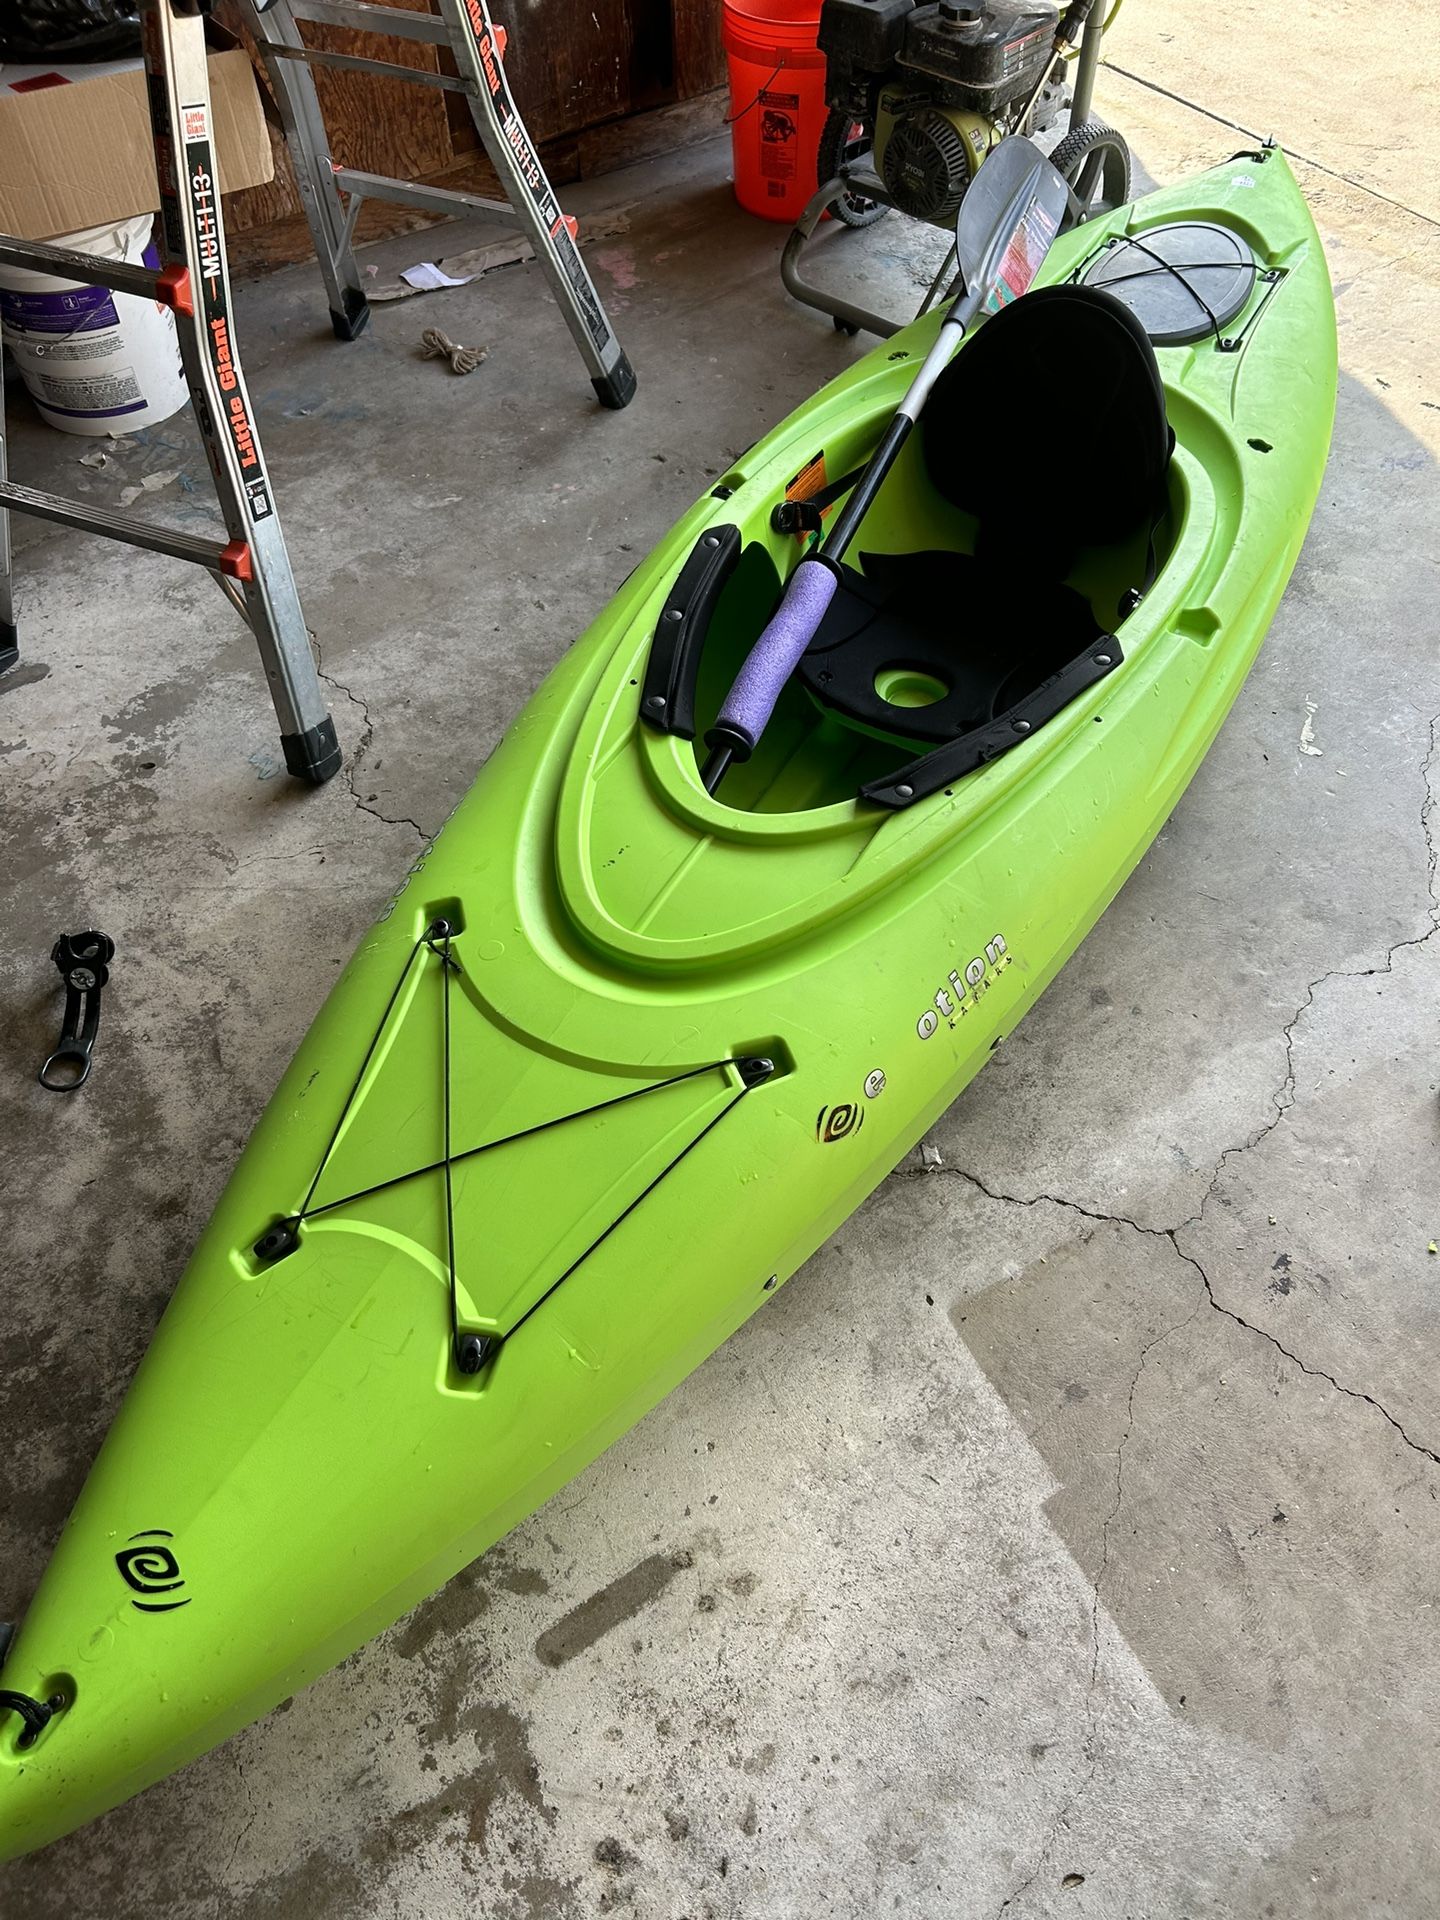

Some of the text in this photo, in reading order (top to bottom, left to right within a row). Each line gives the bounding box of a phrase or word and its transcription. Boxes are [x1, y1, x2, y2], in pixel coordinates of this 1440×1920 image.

[480, 35, 500, 96] Giant
[185, 111, 205, 124] Little
[503, 113, 531, 169] MULTI
[192, 173, 221, 279] MULTI 13
[210, 317, 237, 391] Giant
[230, 396, 257, 468] Little
